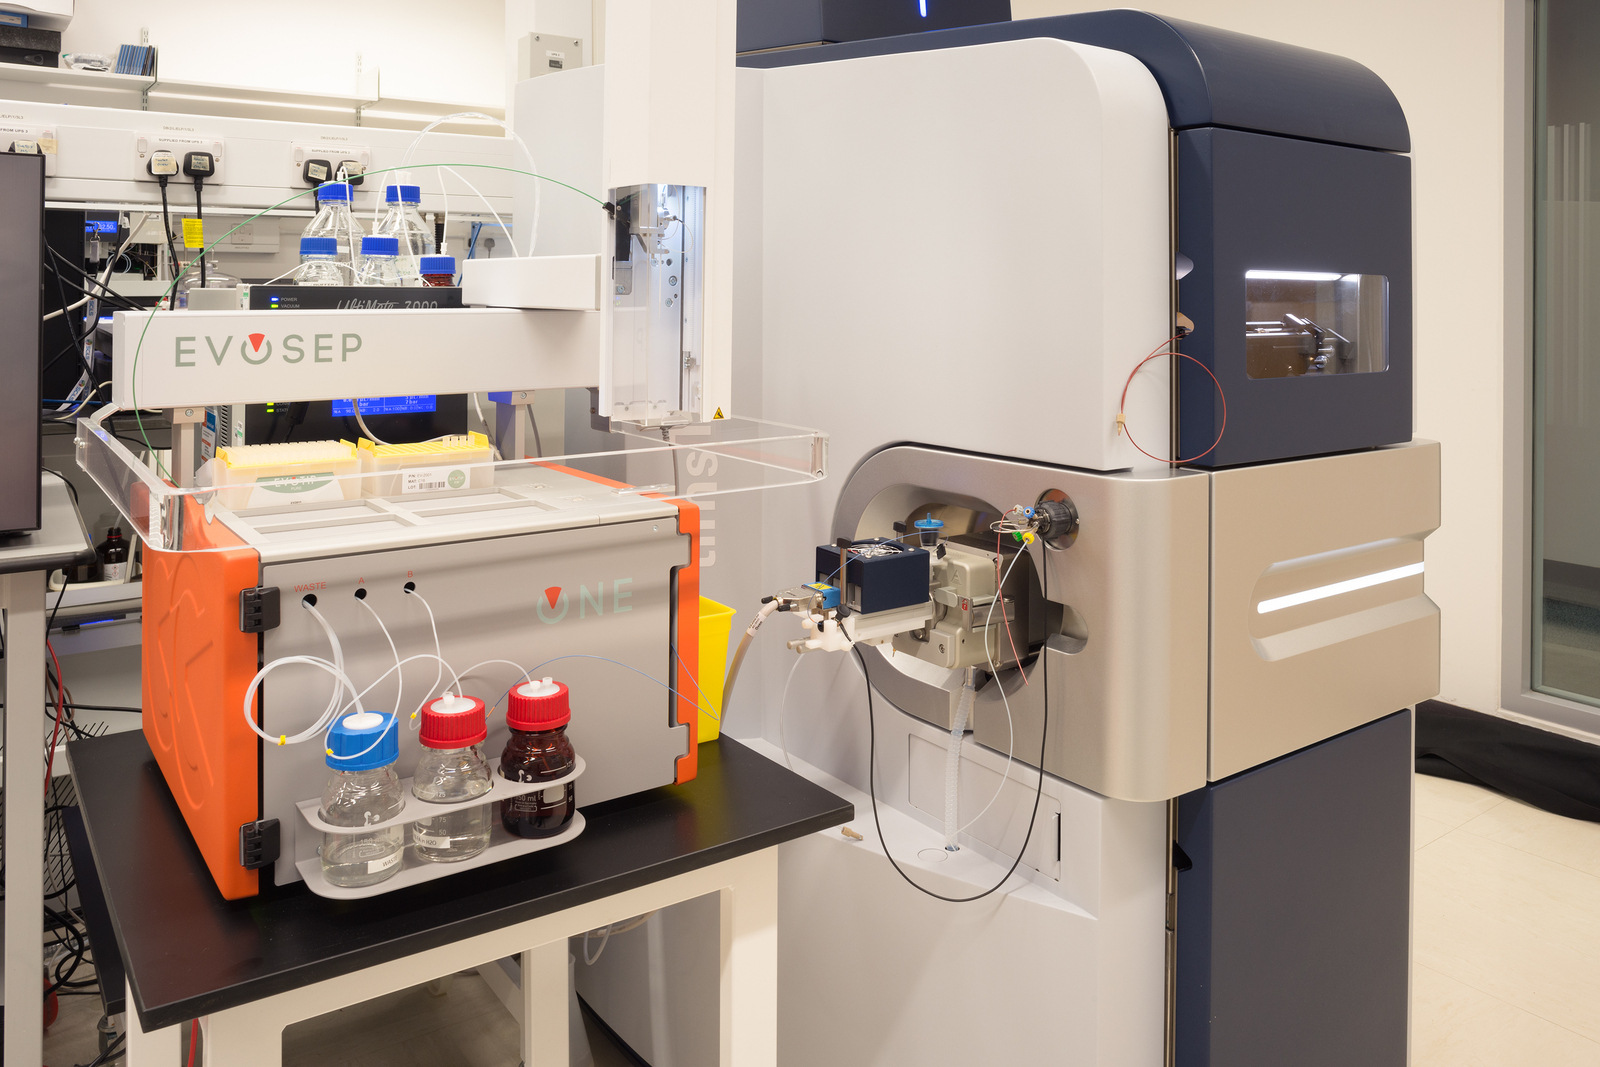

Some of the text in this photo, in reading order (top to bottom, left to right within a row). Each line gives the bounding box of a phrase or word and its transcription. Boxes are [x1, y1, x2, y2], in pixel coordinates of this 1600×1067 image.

[175, 333, 362, 367] EVOSEP
[294, 581, 327, 593] WASTE
[536, 578, 633, 624] ONE
